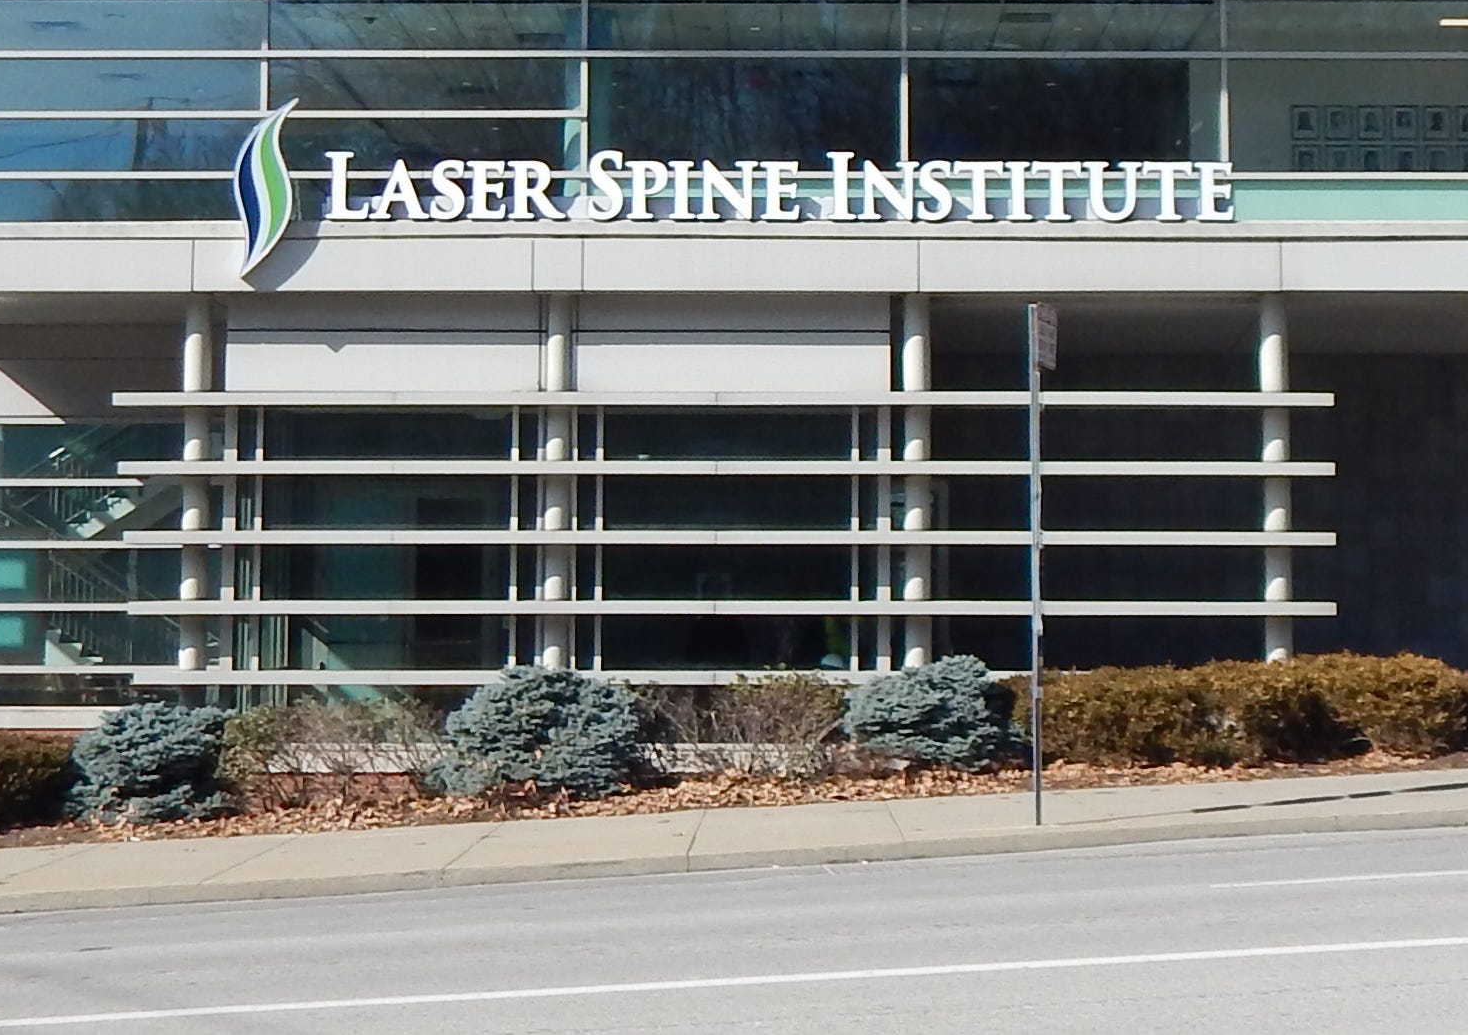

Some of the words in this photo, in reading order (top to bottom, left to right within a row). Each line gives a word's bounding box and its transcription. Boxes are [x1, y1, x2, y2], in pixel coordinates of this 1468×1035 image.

[322, 148, 560, 223] LASER
[585, 149, 802, 224] SPINE
[824, 151, 1235, 225] INSTITUTE
